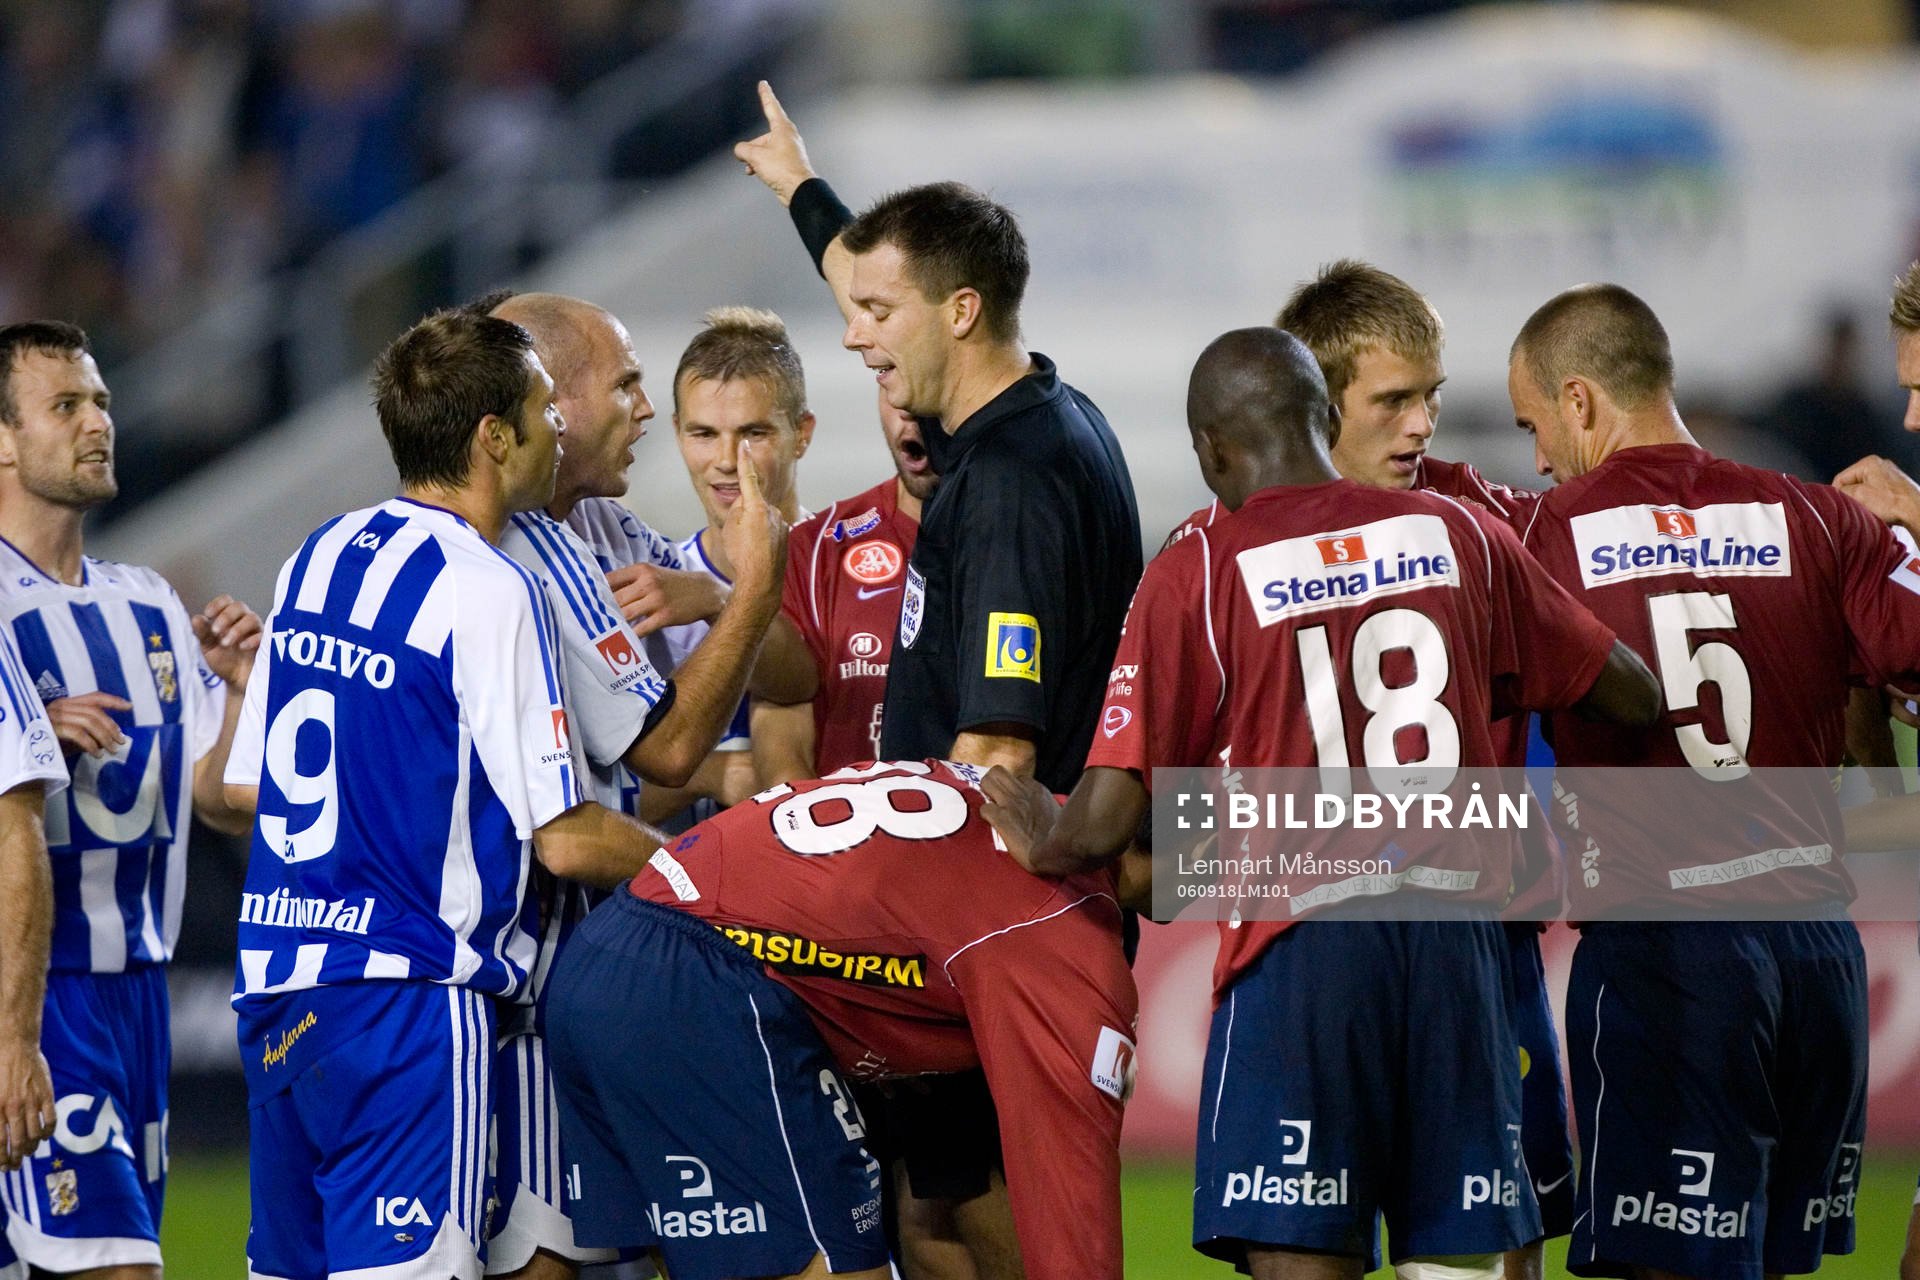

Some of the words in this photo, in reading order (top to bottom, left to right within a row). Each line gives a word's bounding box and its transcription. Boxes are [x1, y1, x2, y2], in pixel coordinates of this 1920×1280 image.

[352, 530, 383, 550] ICA
[1335, 540, 1348, 562] S
[1591, 541, 1697, 576] Stena
[1700, 536, 1781, 566] Line
[1263, 571, 1369, 612] Stena
[1374, 551, 1452, 587] Line
[903, 612, 916, 633] FIFA
[271, 628, 396, 689] VOLVO
[609, 670, 641, 691] SVENSKA
[1649, 591, 1752, 781] 5
[1296, 608, 1462, 821] 18
[259, 688, 339, 865] 9
[541, 750, 572, 764] SVENS
[1673, 853, 1777, 886] WEAVERIN
[238, 886, 376, 935] ntinntal
[714, 925, 925, 988] Walensta
[262, 1010, 318, 1072] Änglarna
[1096, 1075, 1121, 1095] SVENS
[1221, 1165, 1349, 1207] plastal
[375, 1196, 434, 1227] ICA
[645, 1200, 768, 1238] lastal
[1611, 1191, 1750, 1239] plastal
